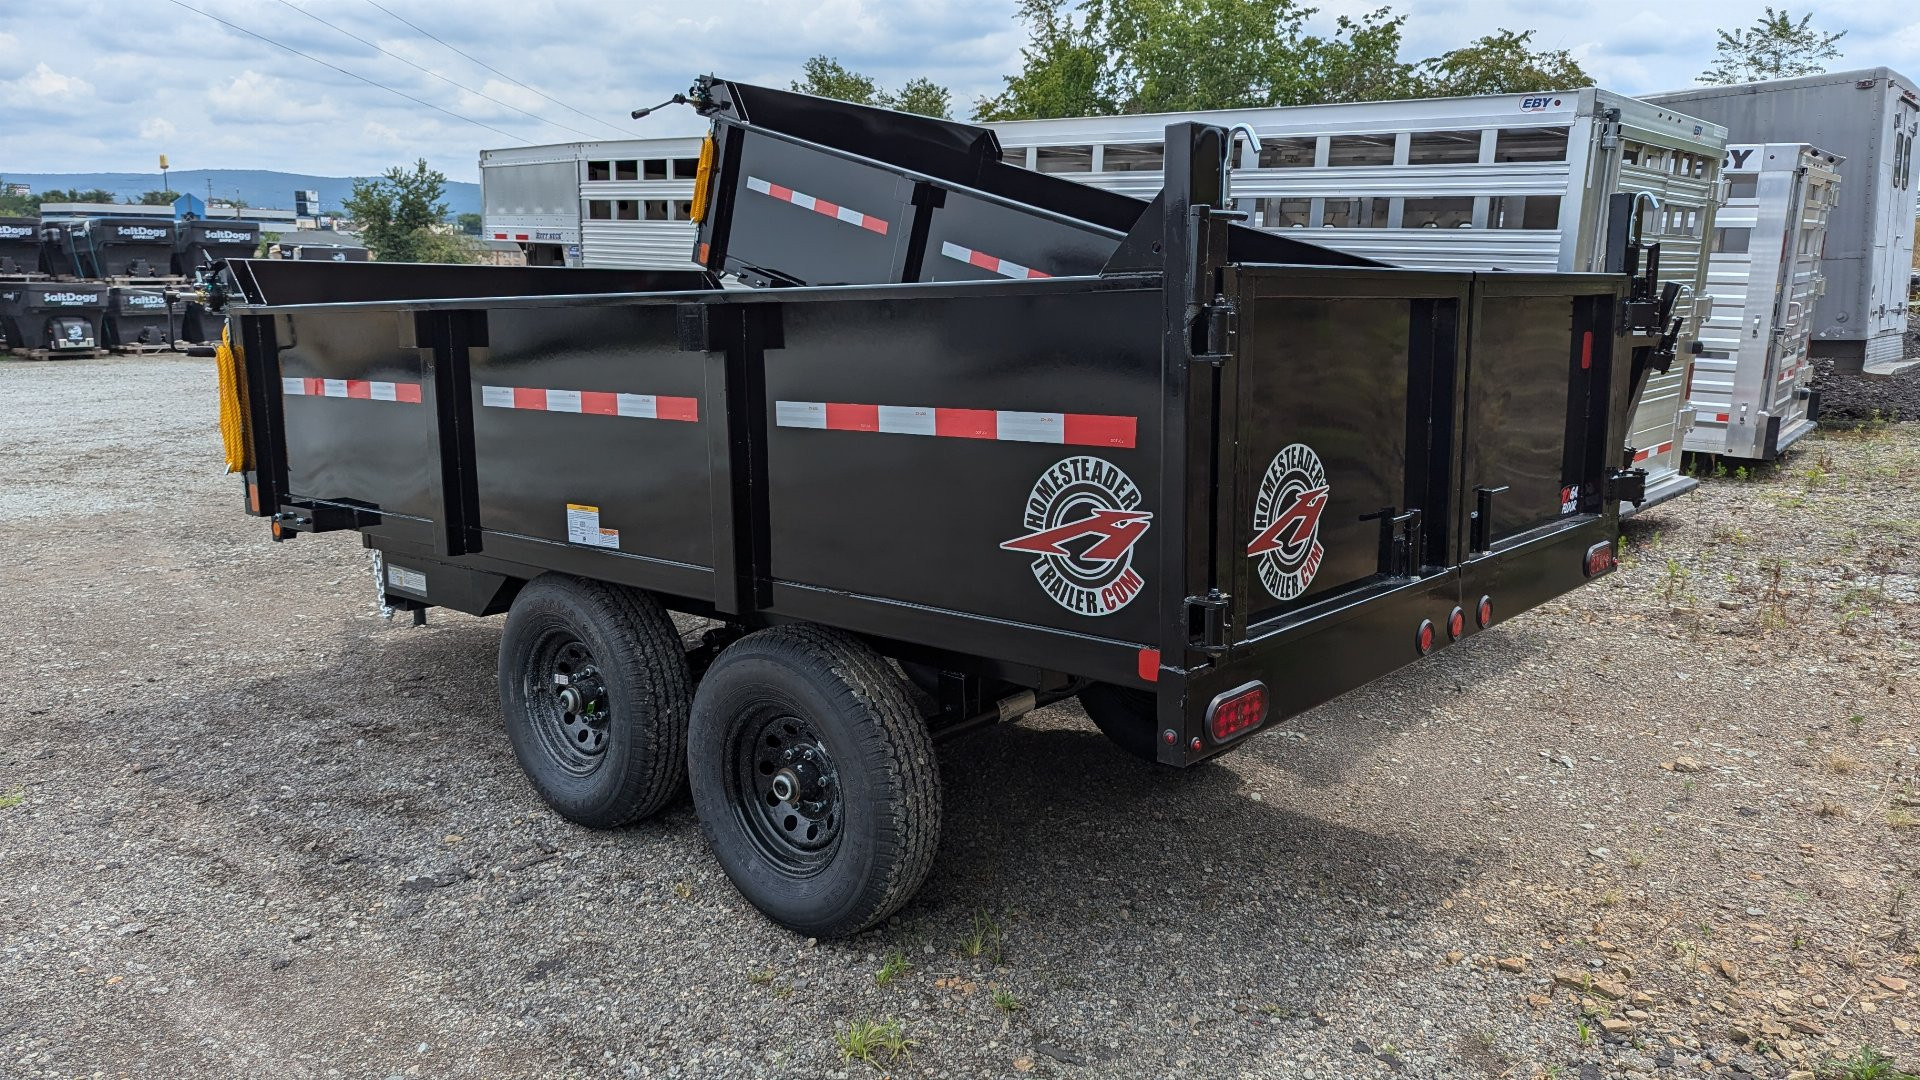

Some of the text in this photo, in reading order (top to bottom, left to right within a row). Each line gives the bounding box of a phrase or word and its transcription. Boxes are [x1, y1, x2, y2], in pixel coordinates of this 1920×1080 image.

[1522, 98, 1553, 108] EBY
[0, 226, 33, 236] tDogg
[117, 226, 167, 237] SaltDogg
[204, 230, 252, 240] SaltDogg
[43, 292, 98, 303] SaltDogg
[128, 296, 164, 305] SaltDo
[1255, 446, 1324, 529] HOMESTEADER
[1026, 458, 1140, 530] HOMESTEADER
[1258, 544, 1324, 599] TRAILER.COM
[1031, 553, 1143, 614] TRAILER.COM
